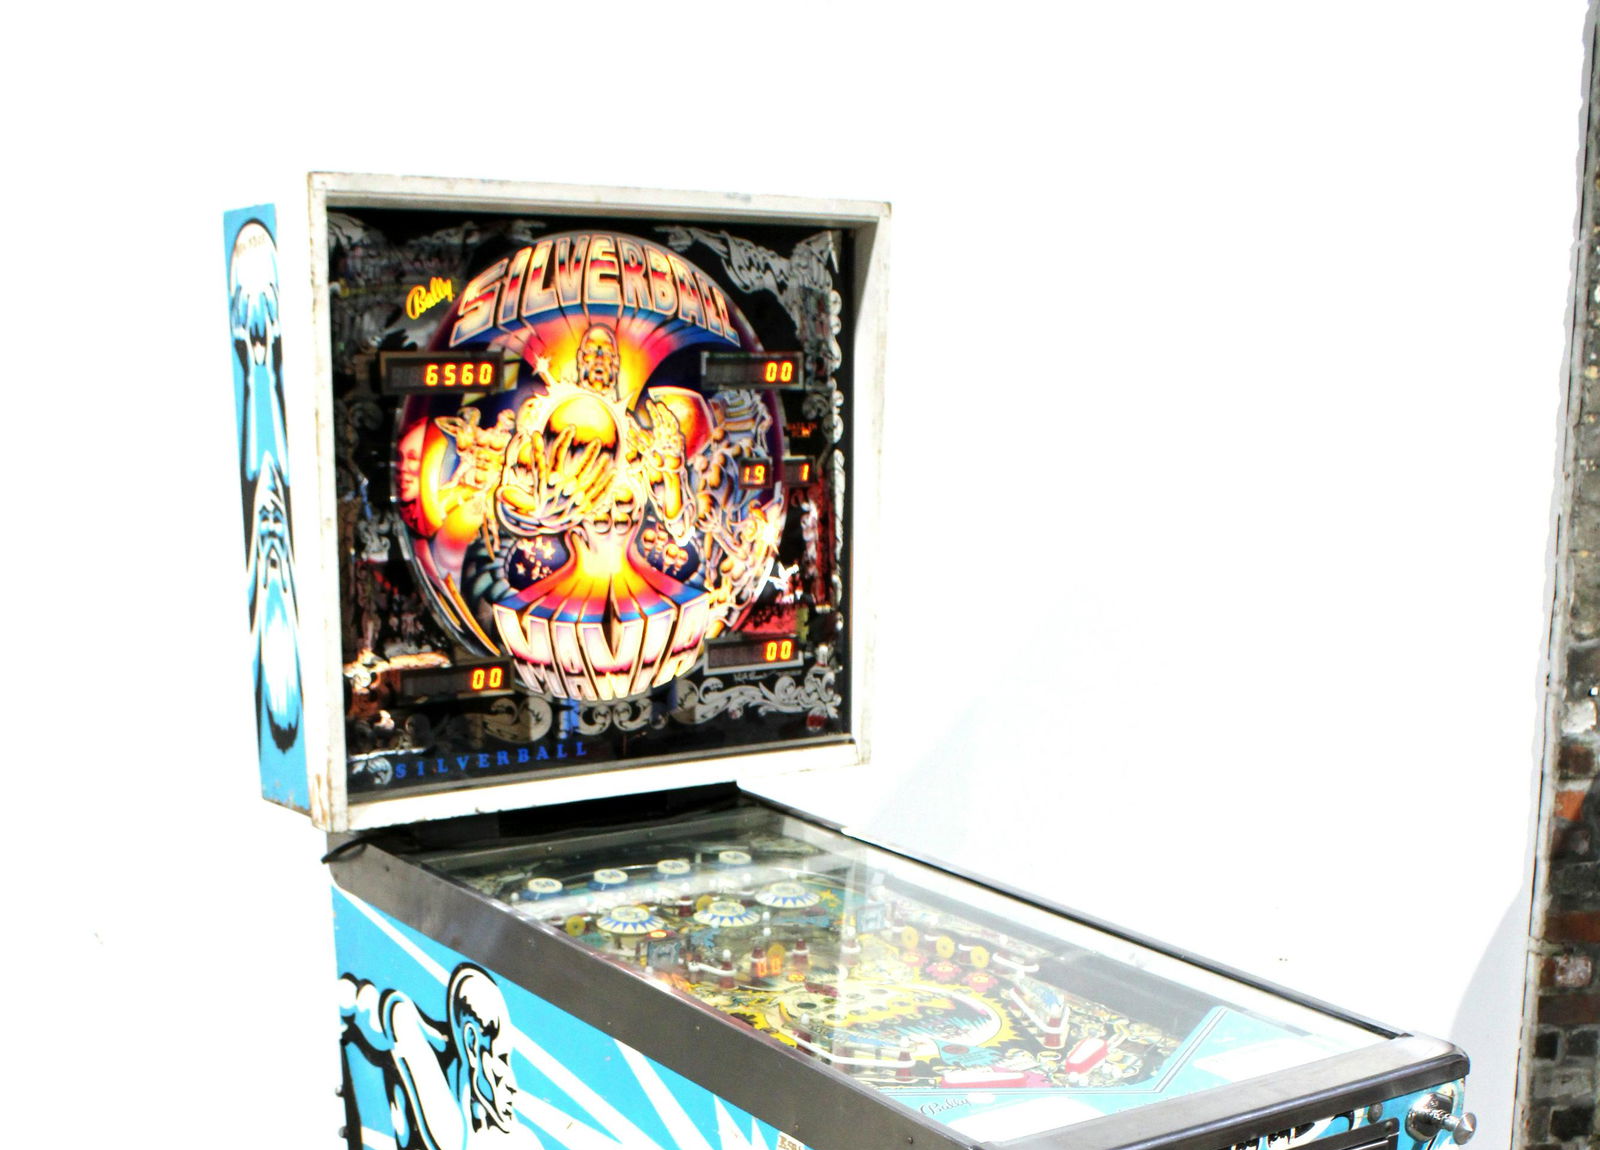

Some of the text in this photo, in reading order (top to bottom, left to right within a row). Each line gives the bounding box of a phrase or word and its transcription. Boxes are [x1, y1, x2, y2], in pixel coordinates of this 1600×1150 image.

[406, 276, 454, 320] Bally
[450, 234, 741, 347] SILVERBALL
[425, 362, 493, 386] 6560
[765, 361, 793, 382] 00
[743, 464, 765, 484] 19
[802, 464, 809, 481] 1
[492, 593, 710, 701] MANIA
[766, 640, 793, 661] 00
[472, 667, 502, 690] 00
[395, 741, 587, 779] SILVERBALL
[920, 1097, 972, 1115] Bally
